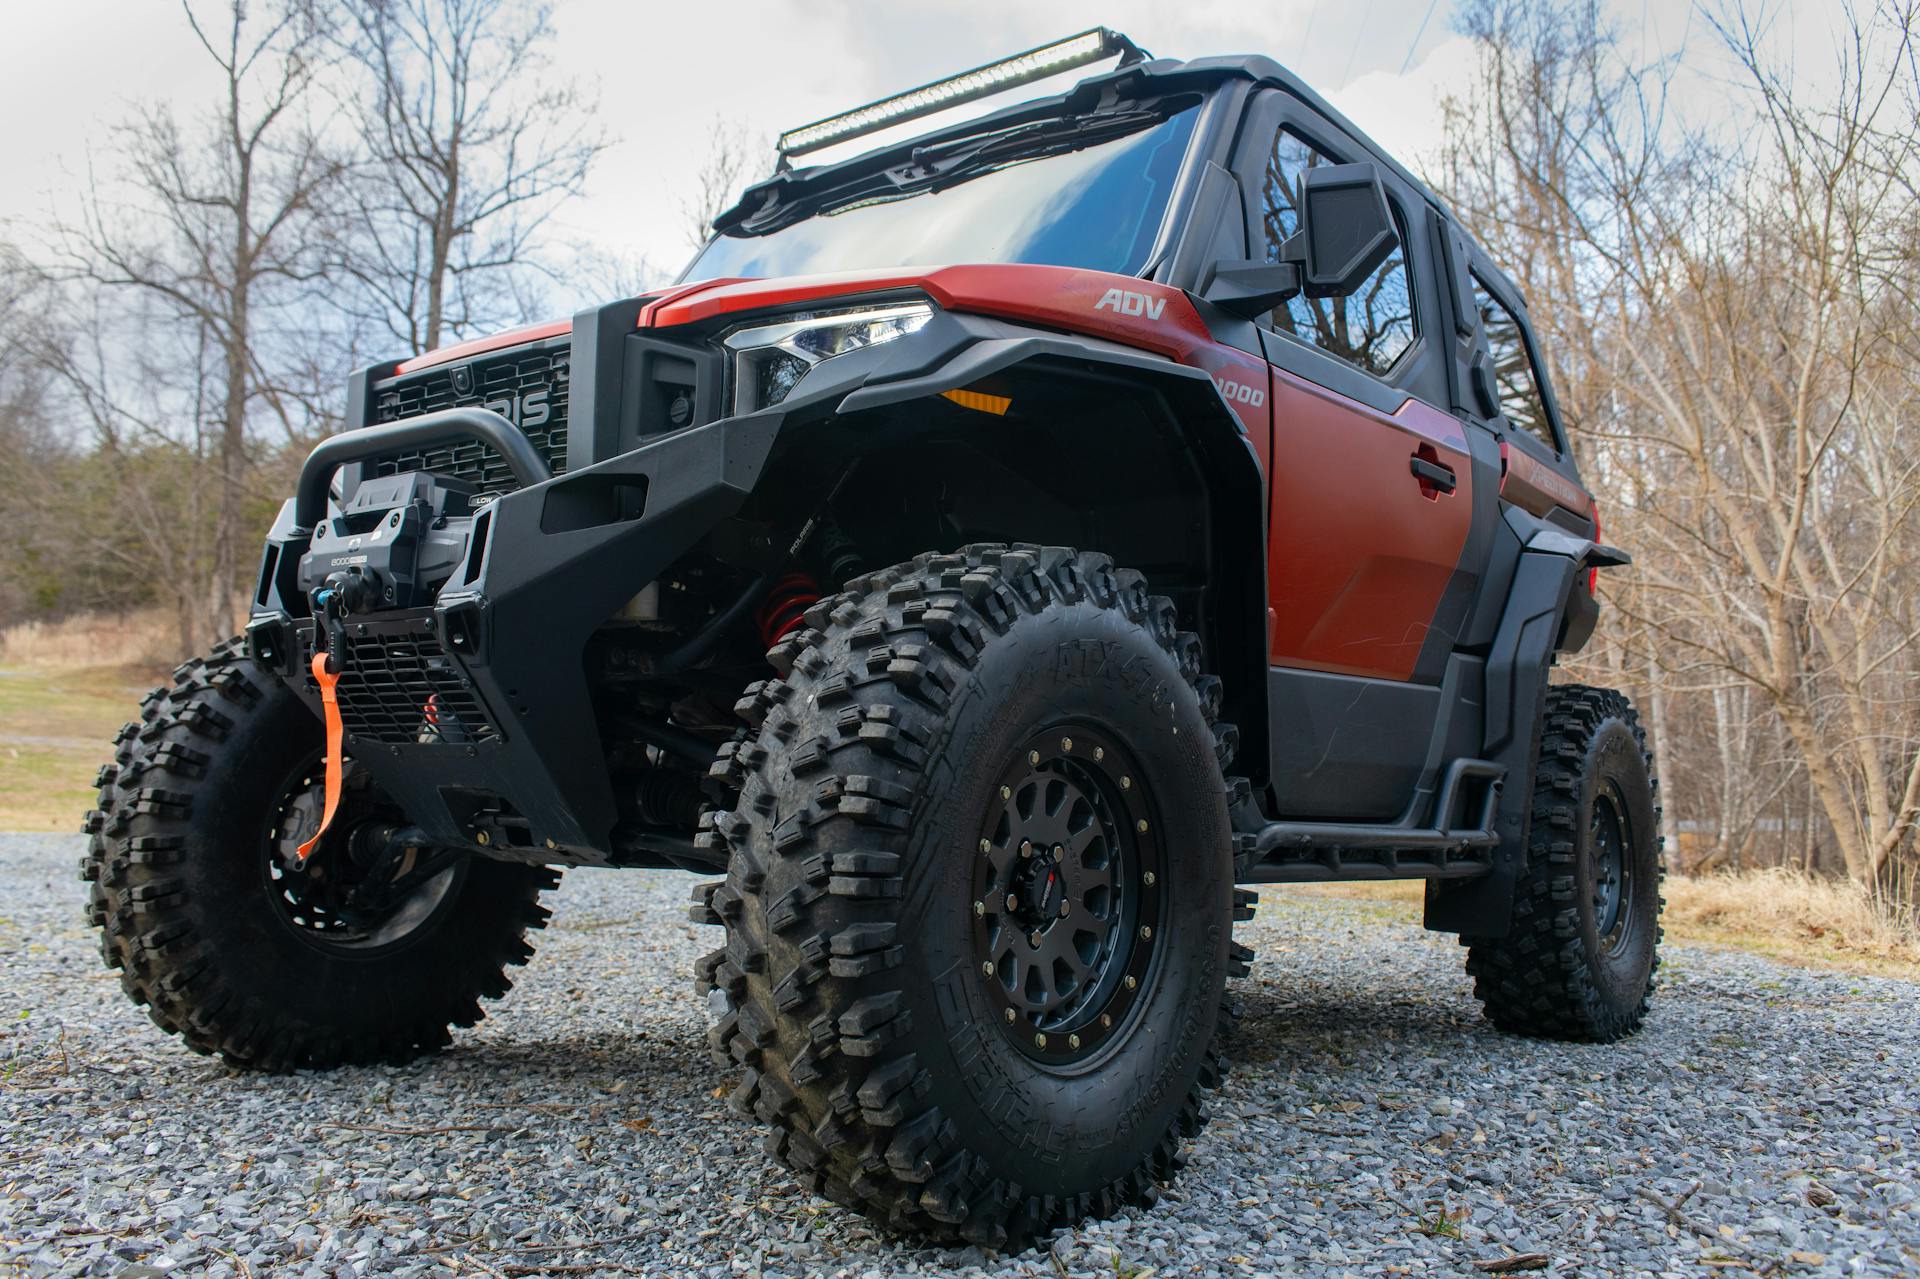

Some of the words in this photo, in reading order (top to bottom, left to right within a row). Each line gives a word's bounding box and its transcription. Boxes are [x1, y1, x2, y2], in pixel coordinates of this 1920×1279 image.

[1094, 288, 1167, 321] ADV
[1217, 377, 1265, 408] 1000
[790, 518, 814, 554] POLARIS
